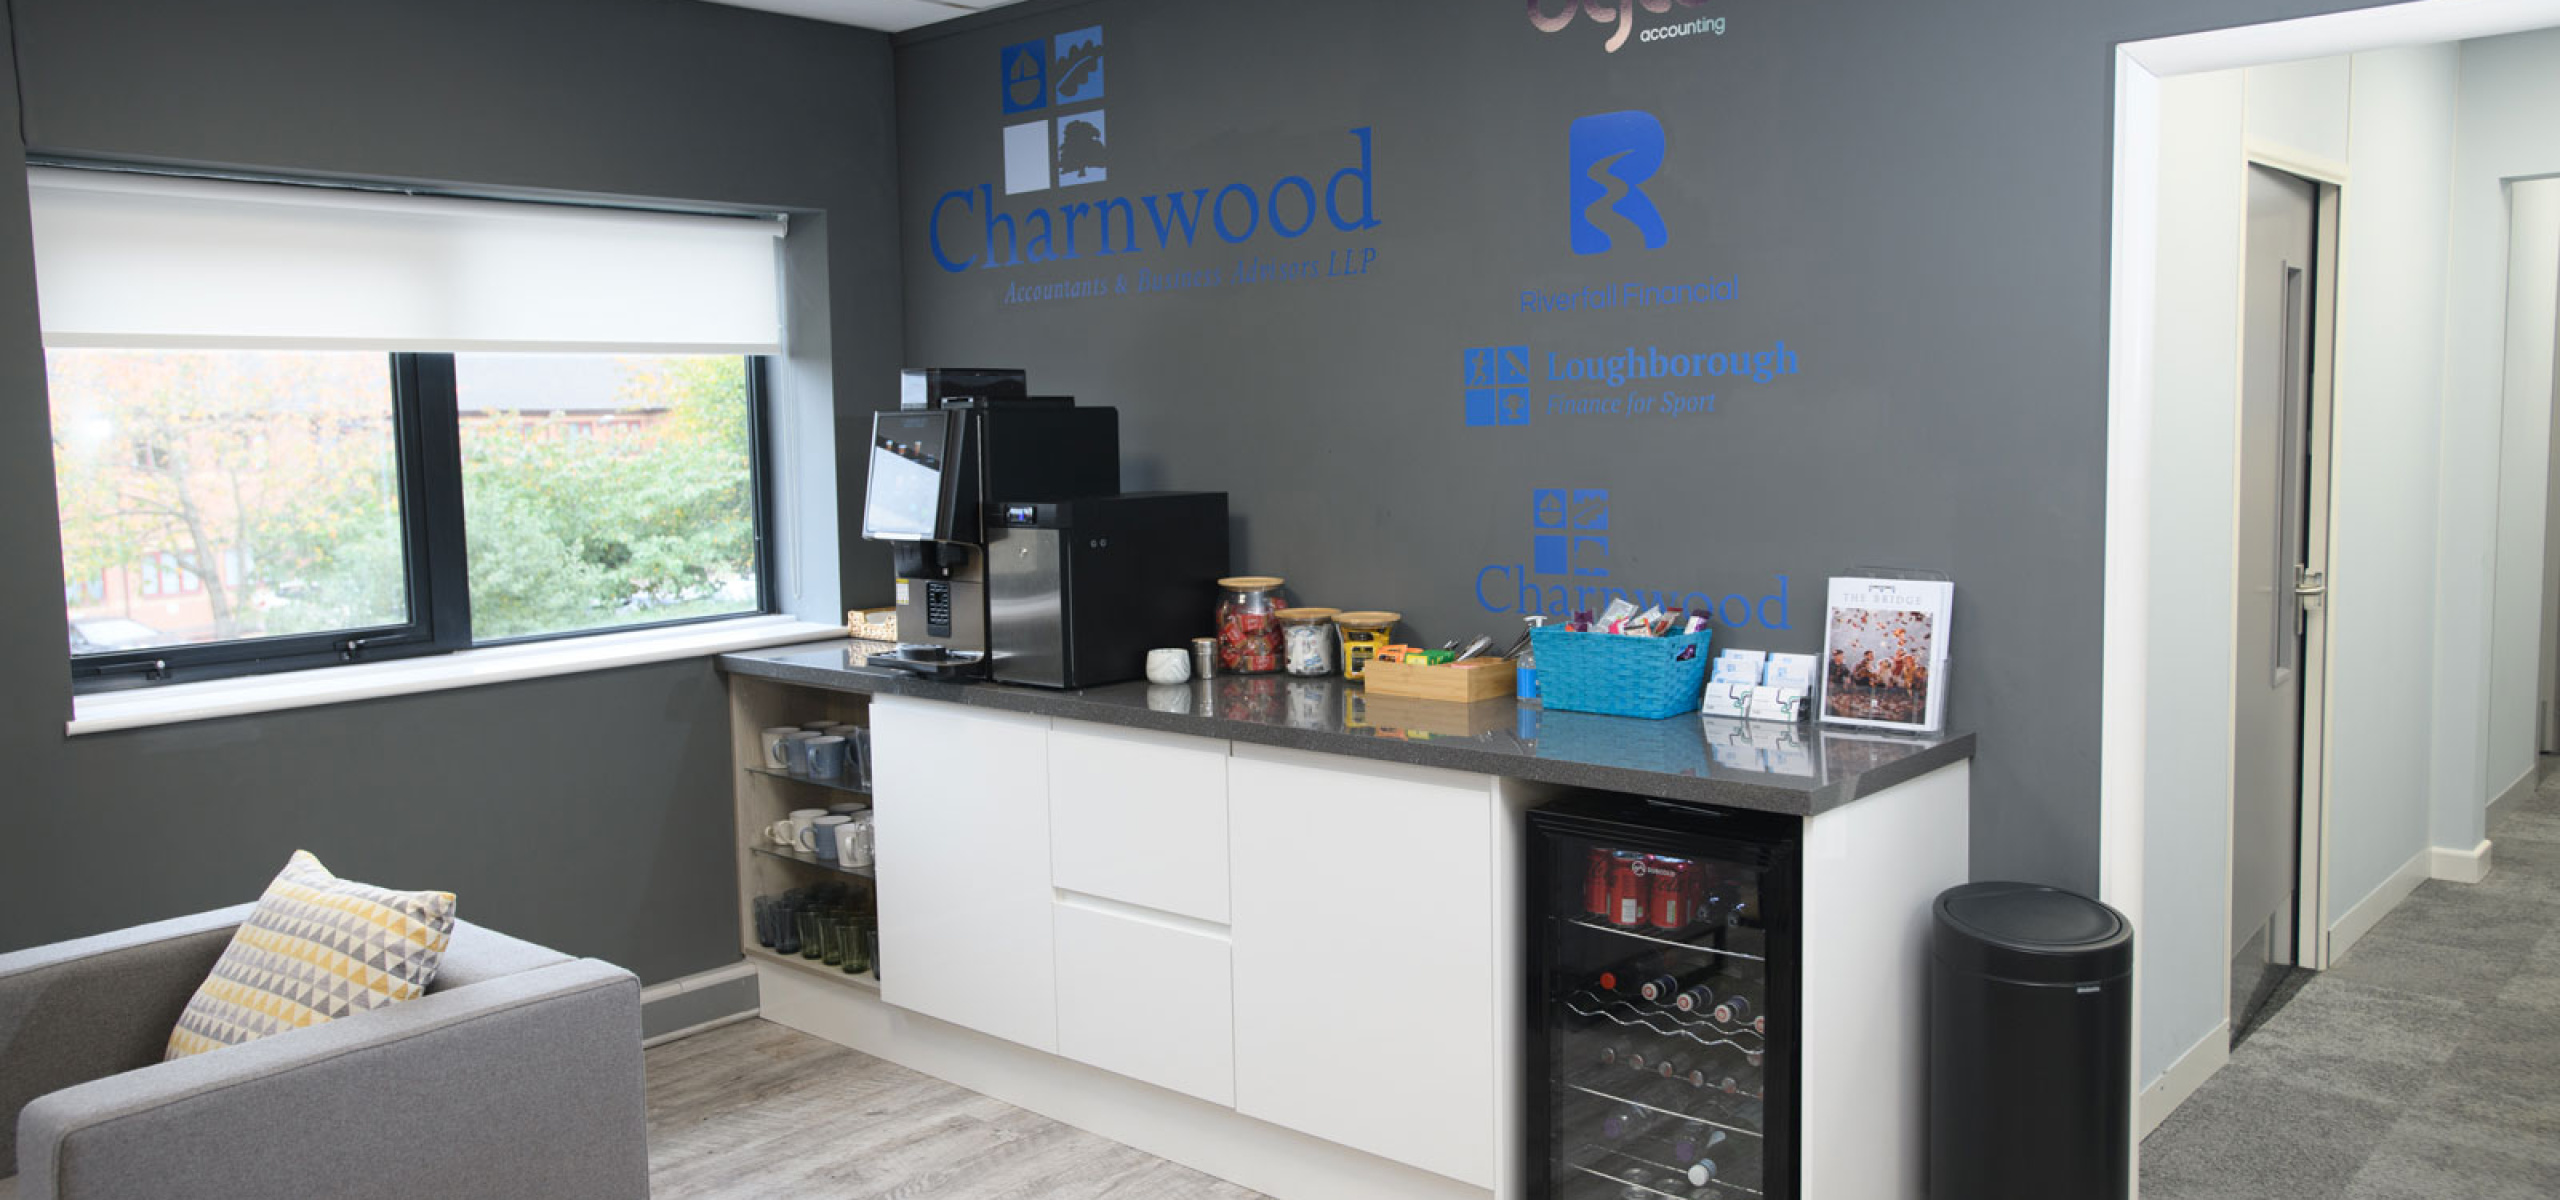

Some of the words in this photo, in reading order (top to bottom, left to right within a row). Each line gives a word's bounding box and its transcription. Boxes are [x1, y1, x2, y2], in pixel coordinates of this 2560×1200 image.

[1640, 17, 1726, 42] accounting
[929, 126, 1382, 273] Charnwood
[1004, 279, 1108, 304] Accountants
[1114, 274, 1128, 294] &
[1138, 264, 1222, 293] Business
[1229, 255, 1320, 287] Advisors
[1327, 247, 1377, 277] LLP
[1520, 283, 1617, 313] Riverfall
[1623, 274, 1739, 308] Financial
[1546, 340, 1800, 388] Loughborough
[1546, 393, 1623, 415] Finance
[1625, 391, 1654, 418] for
[1659, 391, 1716, 418] Sport
